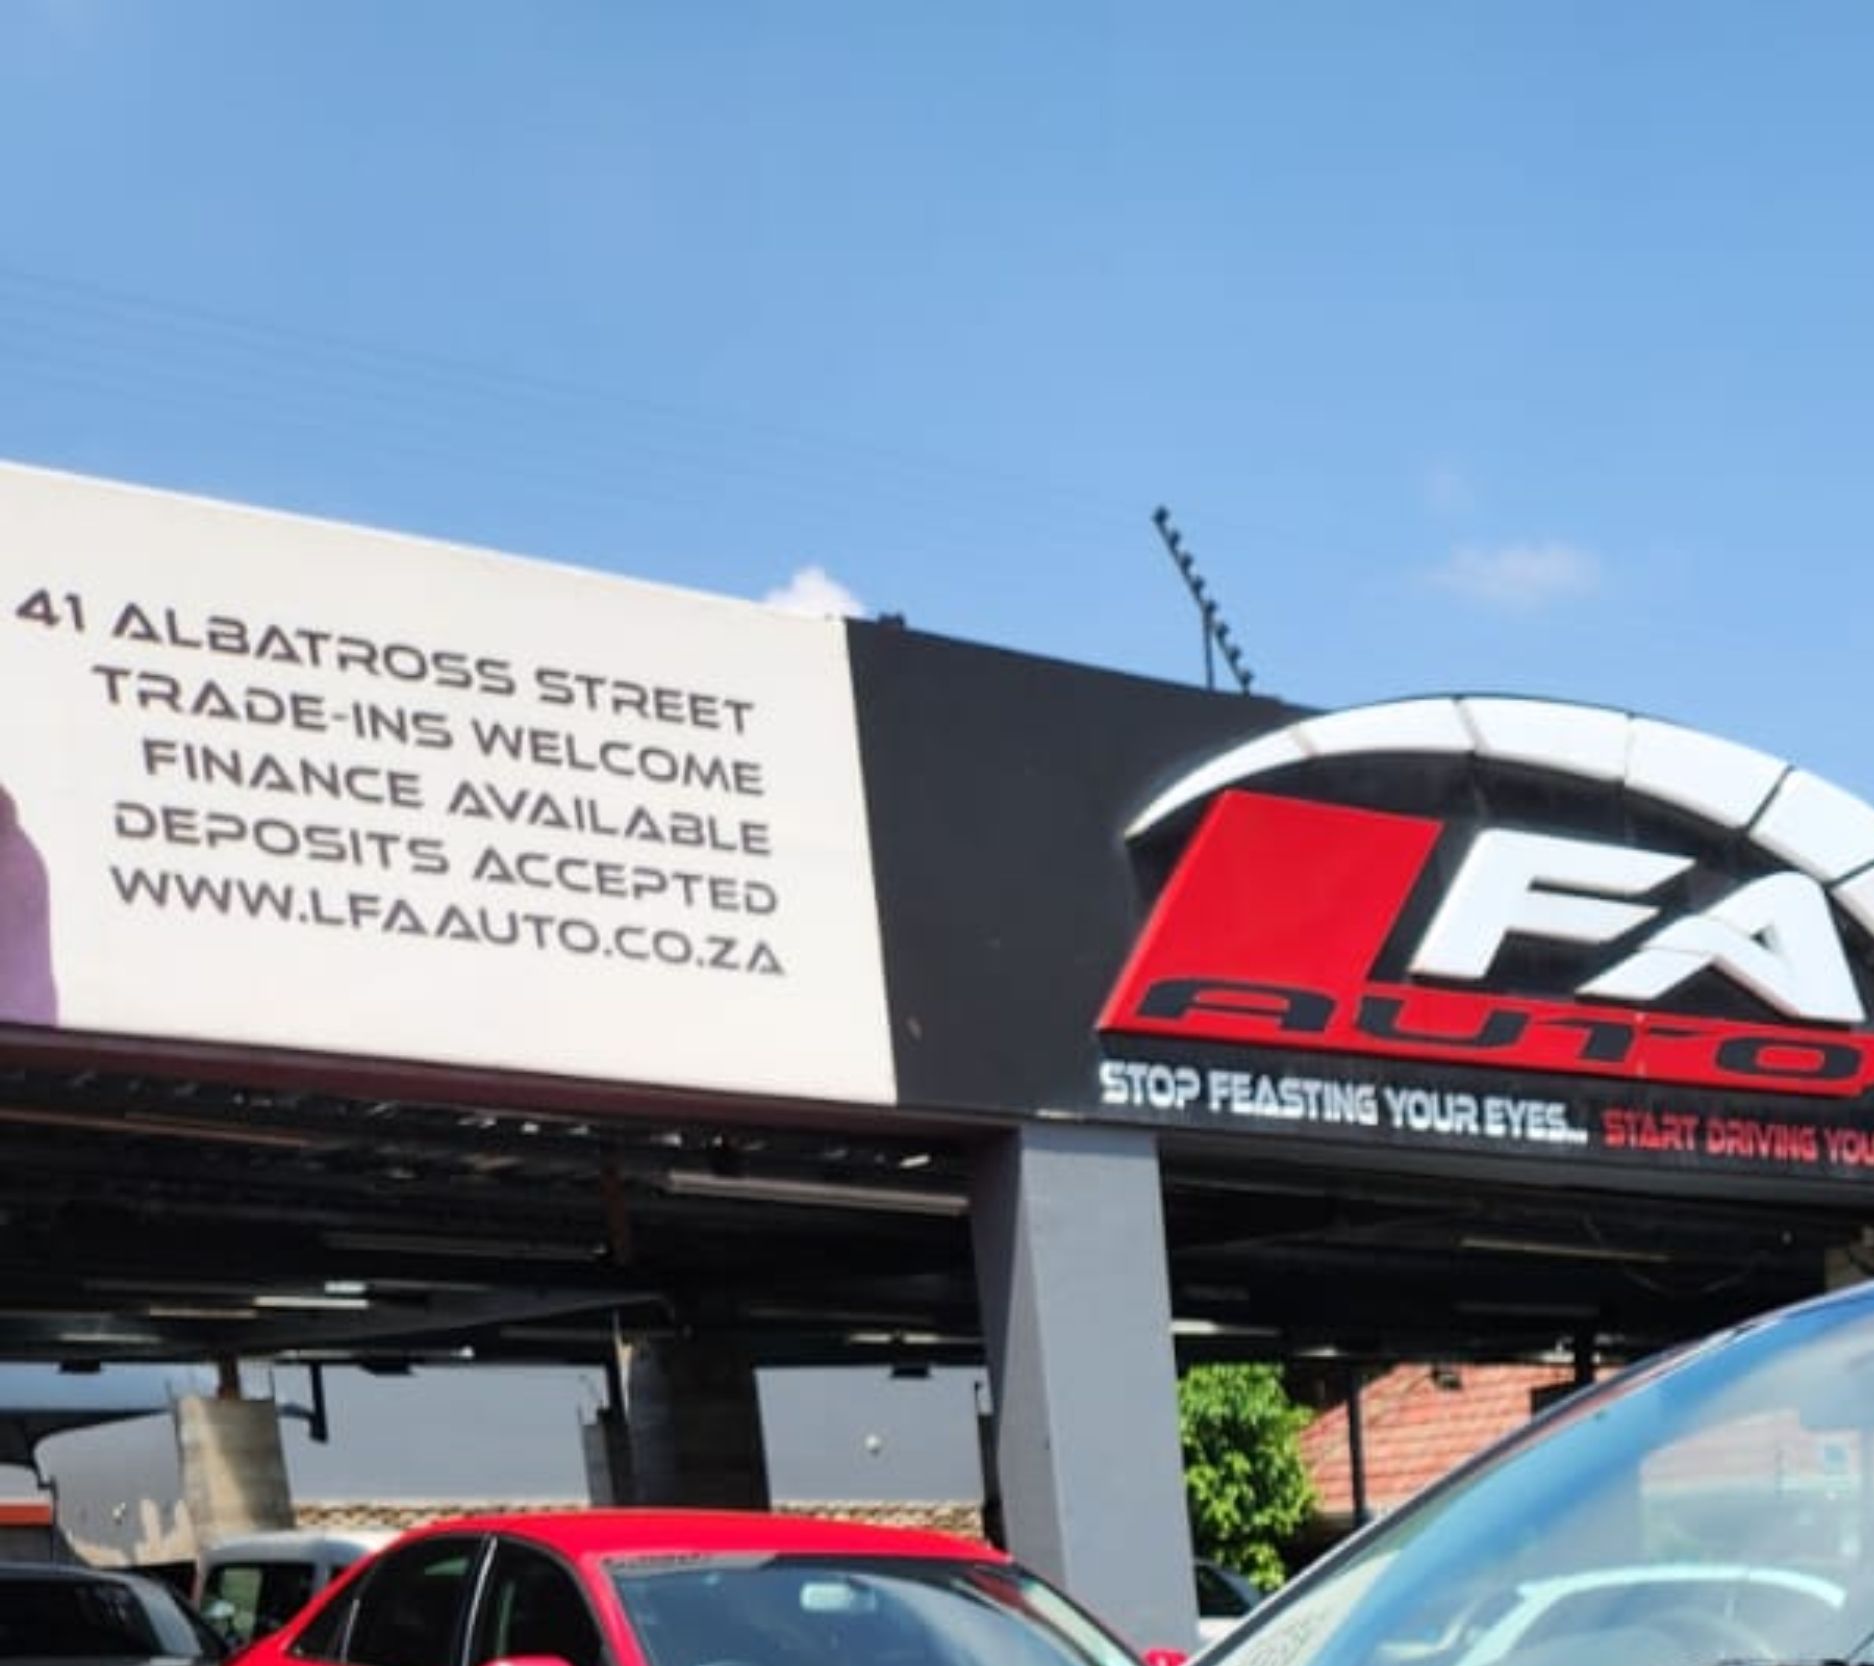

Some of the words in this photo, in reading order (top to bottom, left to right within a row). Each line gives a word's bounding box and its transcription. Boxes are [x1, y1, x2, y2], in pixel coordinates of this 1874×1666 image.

[15, 588, 85, 632] 41
[112, 602, 516, 696] ALBATROSS
[534, 667, 753, 733] STREET
[92, 664, 454, 749] TRADE-INS
[471, 719, 764, 796] WELCOME
[142, 738, 423, 809] FINANCE
[448, 781, 771, 856] AVAILABLE
[115, 801, 450, 875] DEPOSITS
[474, 847, 778, 915] ACCEPTED
[110, 866, 786, 976] WWW.LFAAUTO.CO.ZA
[1134, 975, 1864, 1081] AUTO
[1098, 1060, 1203, 1110] STOP
[1207, 1070, 1379, 1126] FEASTING
[1384, 1087, 1481, 1136] YOUR
[1603, 1110, 1699, 1152] START
[1705, 1120, 1820, 1163] DRIVING
